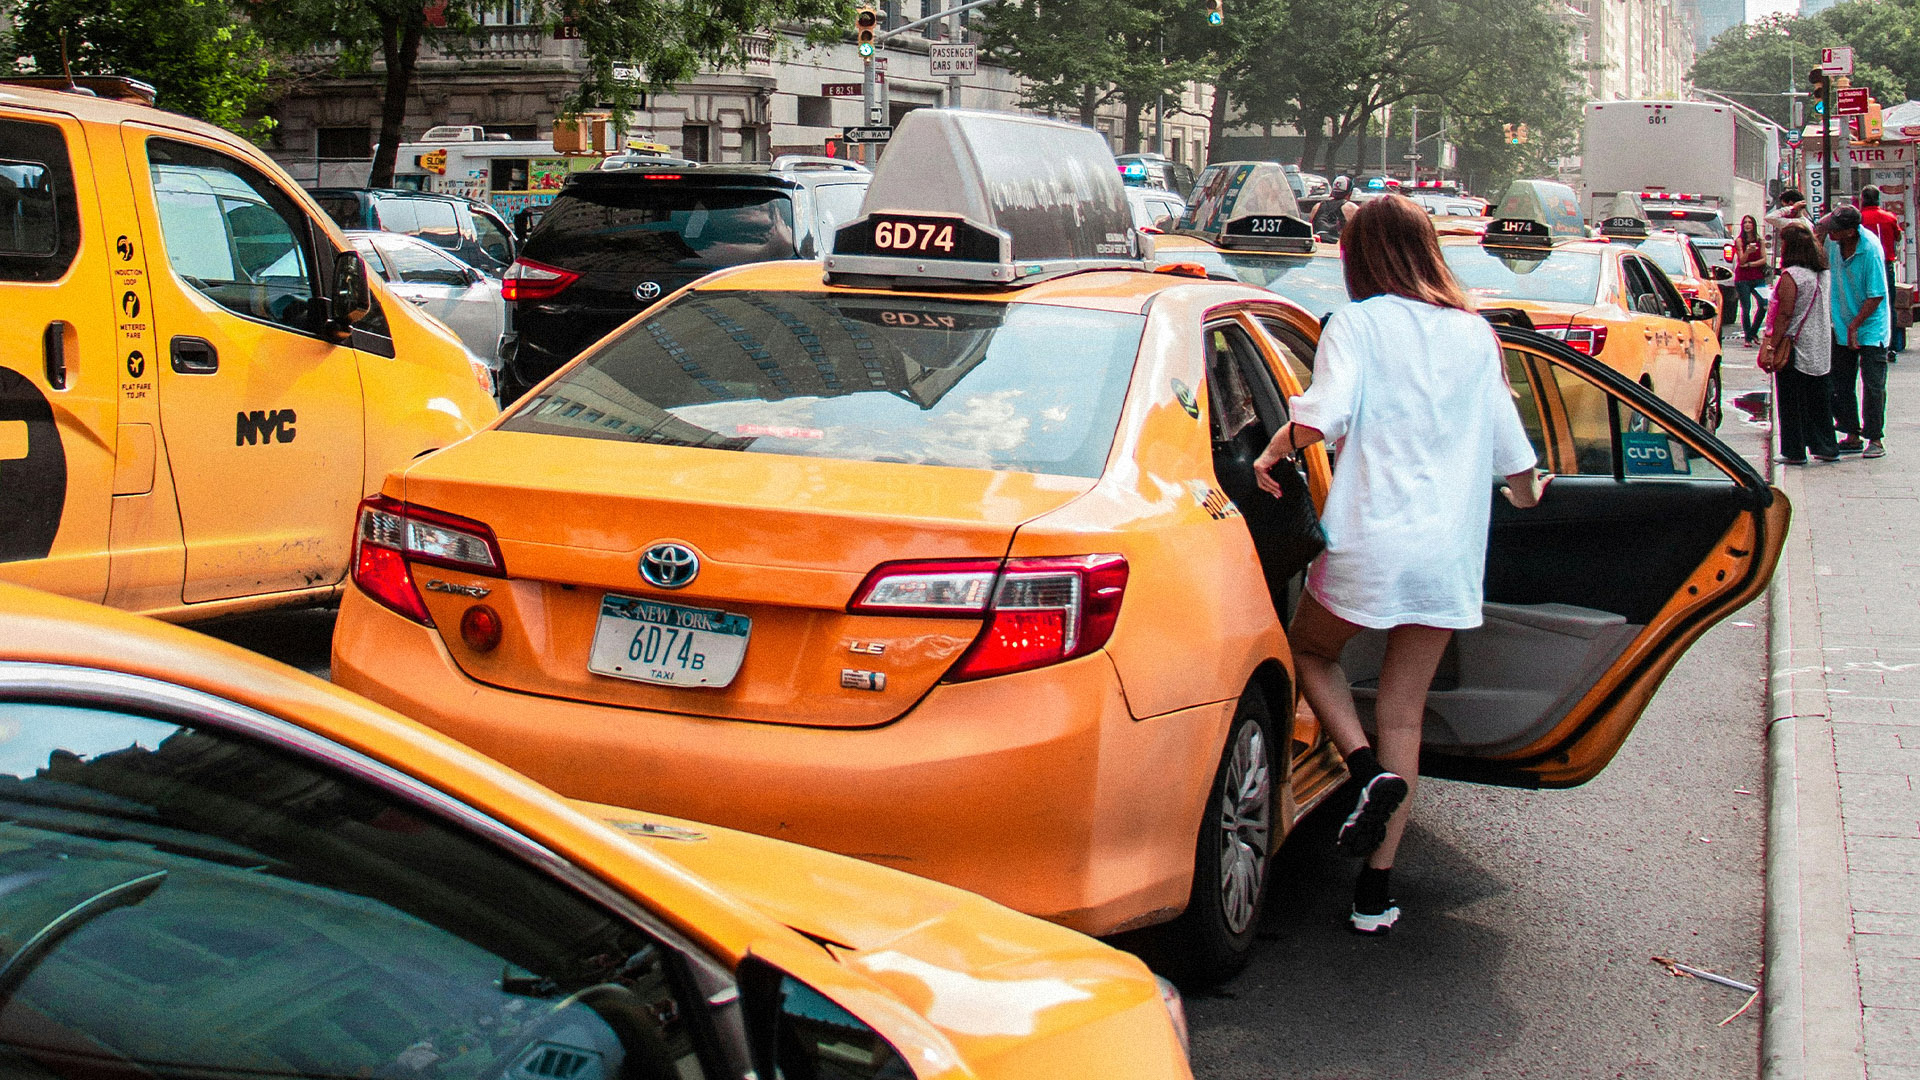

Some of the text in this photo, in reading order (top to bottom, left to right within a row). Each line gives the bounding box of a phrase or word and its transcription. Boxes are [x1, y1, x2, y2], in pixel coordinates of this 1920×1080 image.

[932, 47, 974, 58] PASSENGER
[932, 60, 973, 70] CARS ONLY
[829, 86, 834, 95] E
[835, 86, 844, 95] 82
[1648, 115, 1667, 125] 601
[426, 156, 446, 166] SLOW
[1833, 149, 1885, 162] ATER
[1810, 171, 1823, 203] COLD
[1251, 218, 1283, 233] 2J37
[1501, 221, 1532, 233] 1H74
[1612, 218, 1634, 227] 8D43
[874, 221, 954, 252] 6D74
[236, 409, 296, 446] NYC
[1627, 446, 1667, 459] curb
[425, 579, 492, 600] CAMRY
[636, 604, 714, 631] NEW YORK
[849, 640, 886, 655] LE
[651, 669, 675, 680] TAXI
